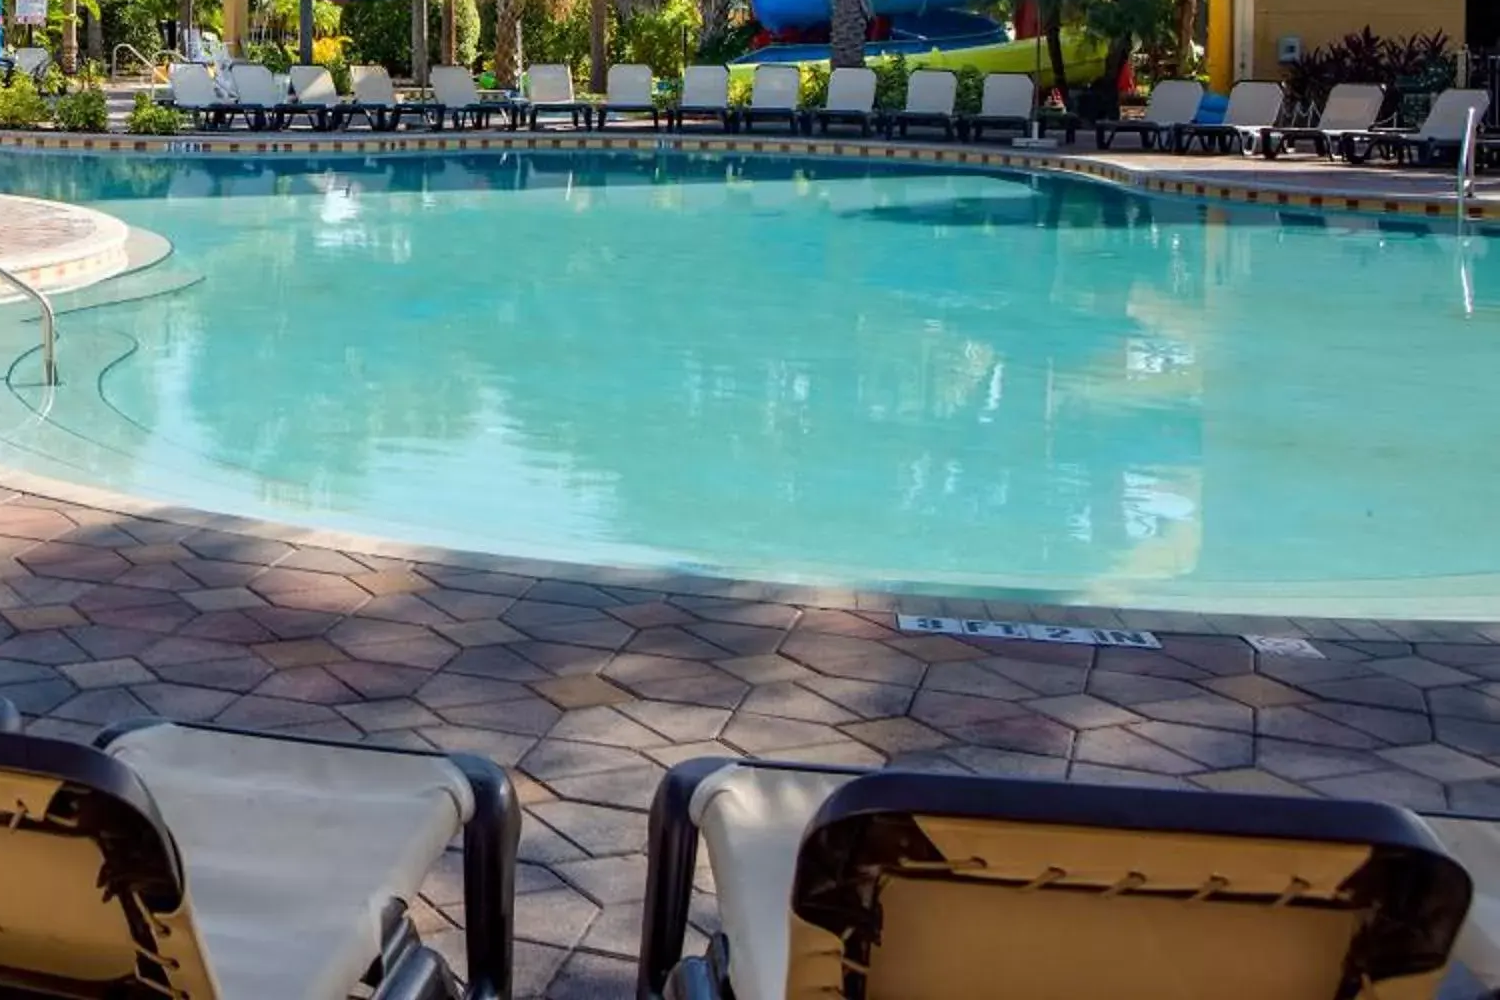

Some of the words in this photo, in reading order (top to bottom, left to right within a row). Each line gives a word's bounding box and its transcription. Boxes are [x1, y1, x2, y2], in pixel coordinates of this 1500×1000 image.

[966, 621, 1017, 635] FT
[1044, 626, 1072, 639] 2
[1092, 630, 1146, 644] IN
